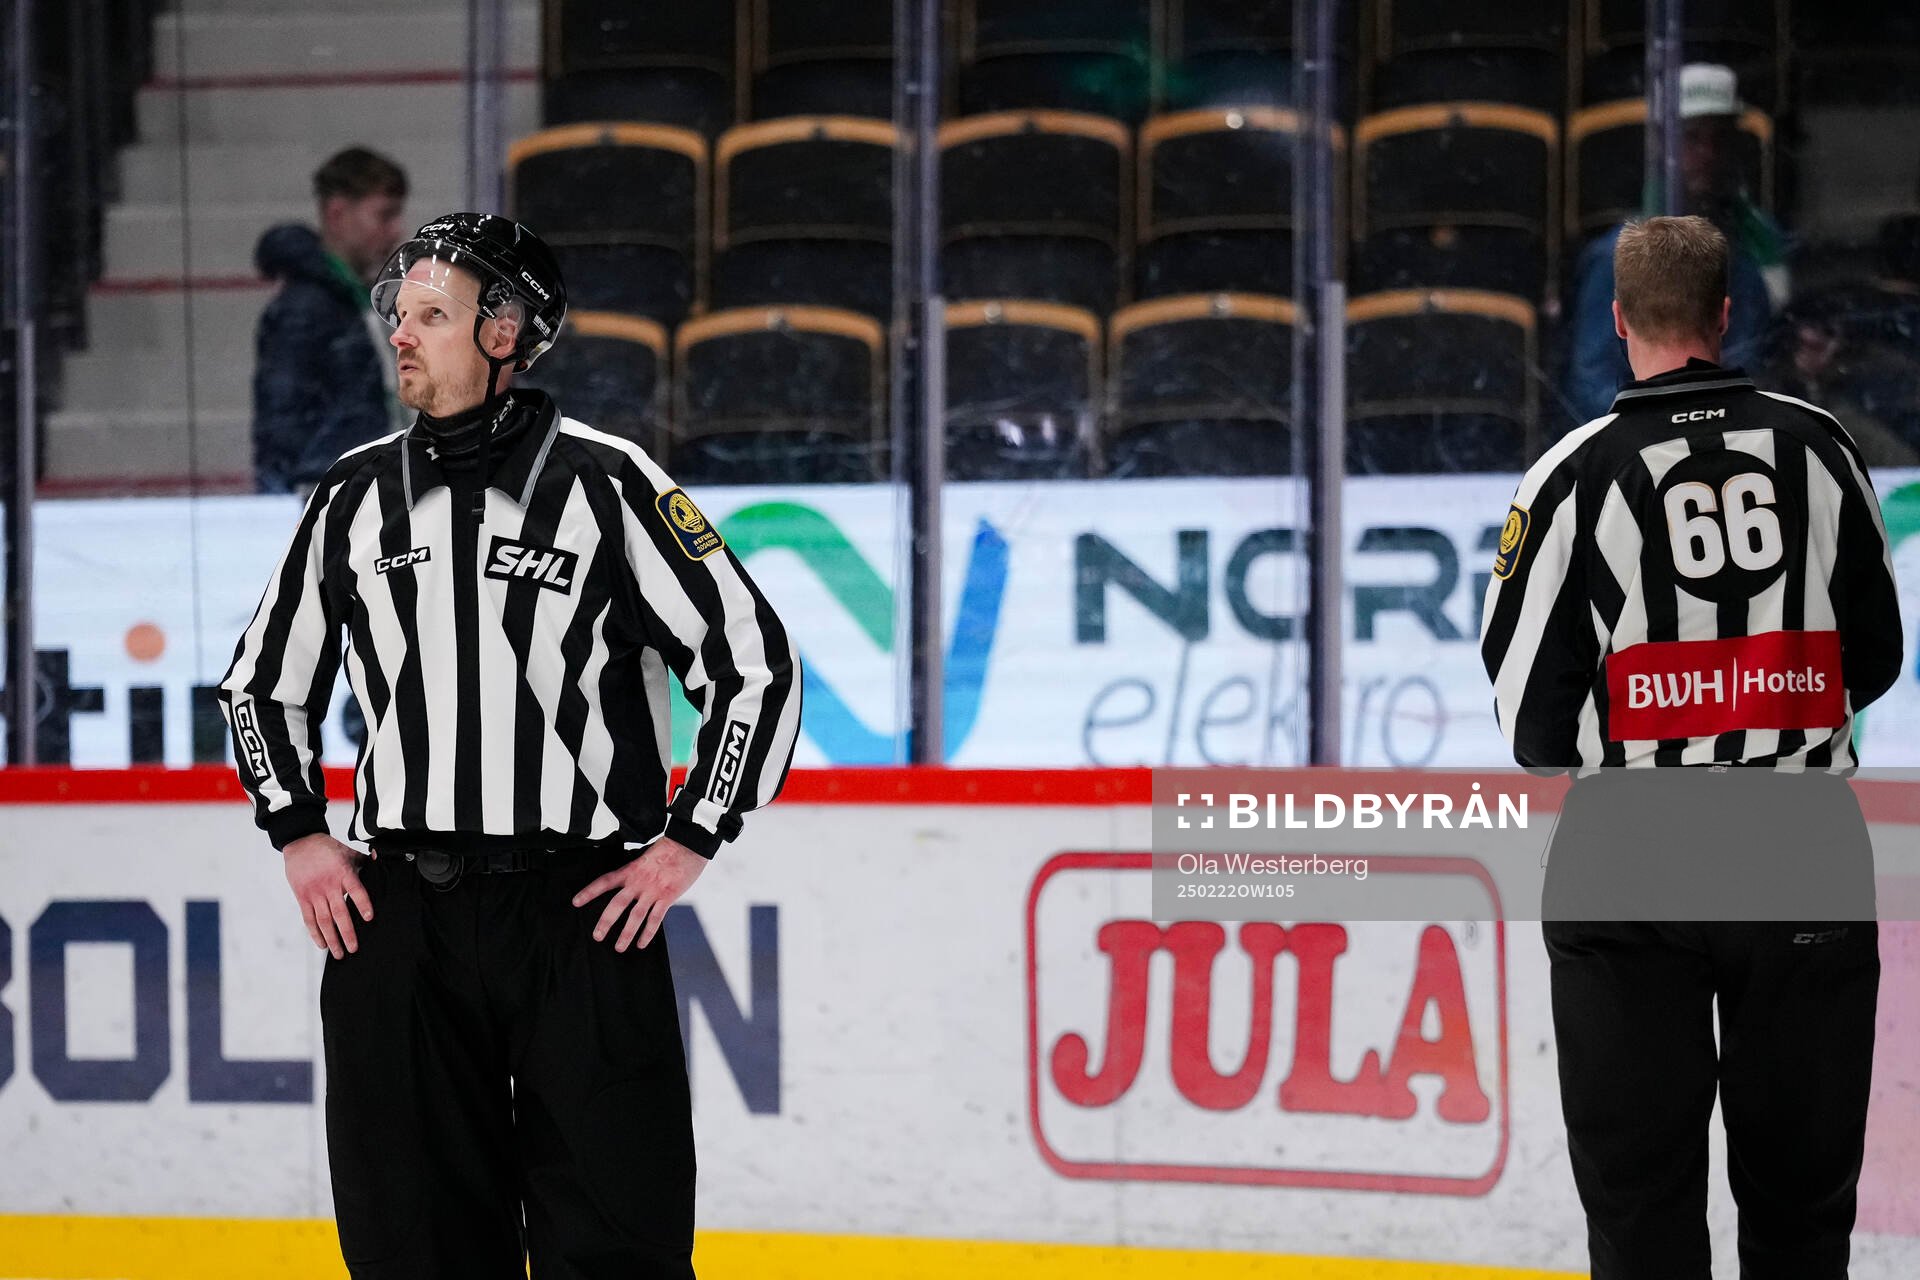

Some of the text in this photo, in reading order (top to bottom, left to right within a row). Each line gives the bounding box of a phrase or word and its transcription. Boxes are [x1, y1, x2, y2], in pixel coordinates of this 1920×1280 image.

[421, 223, 454, 234] CCM
[521, 271, 550, 301] CCM
[1671, 408, 1726, 424] CCM
[1664, 472, 1784, 579] 66
[376, 548, 428, 574] CCM
[488, 545, 570, 588] SHL
[1074, 526, 1502, 643] NOR
[1628, 666, 1826, 710] BWH Hotels
[236, 705, 268, 779] CCM
[713, 724, 746, 807] CCM
[1050, 919, 1491, 1123] JULA
